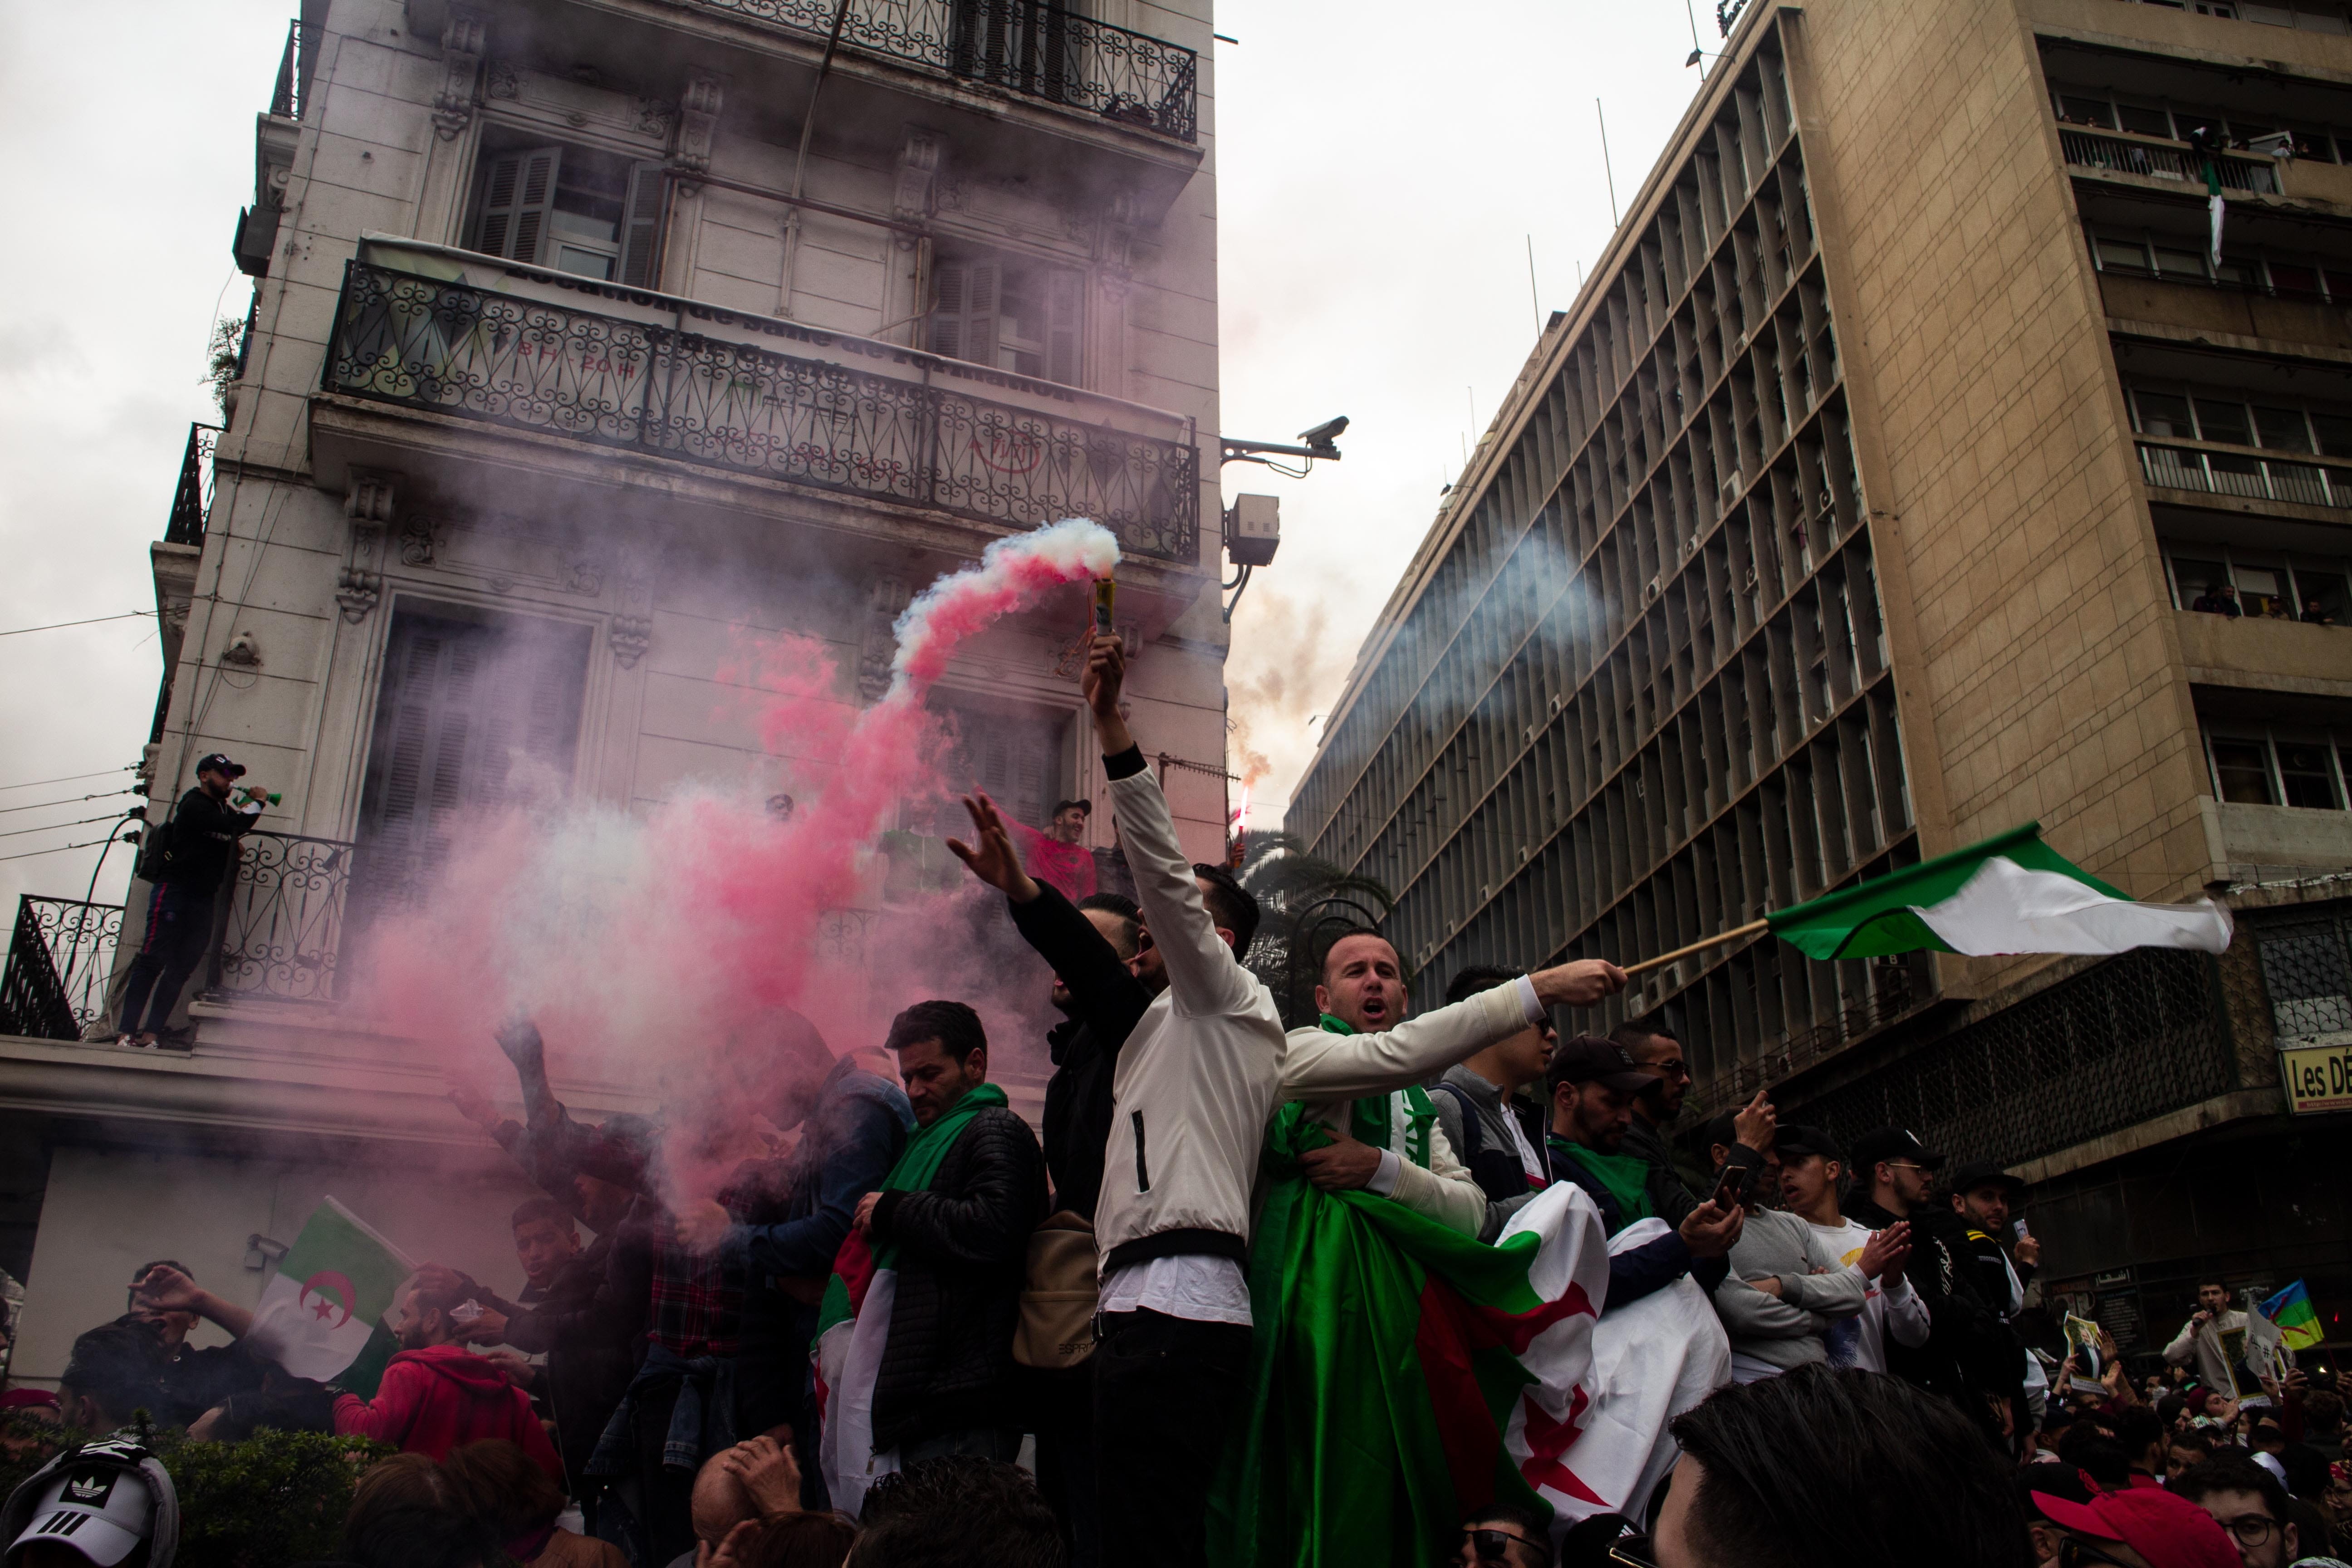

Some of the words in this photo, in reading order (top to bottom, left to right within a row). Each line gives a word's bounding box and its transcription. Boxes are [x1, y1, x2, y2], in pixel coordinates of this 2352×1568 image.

[580, 355, 611, 372] 20
[617, 363, 635, 379] H
[2292, 1059, 2326, 1098] Les
